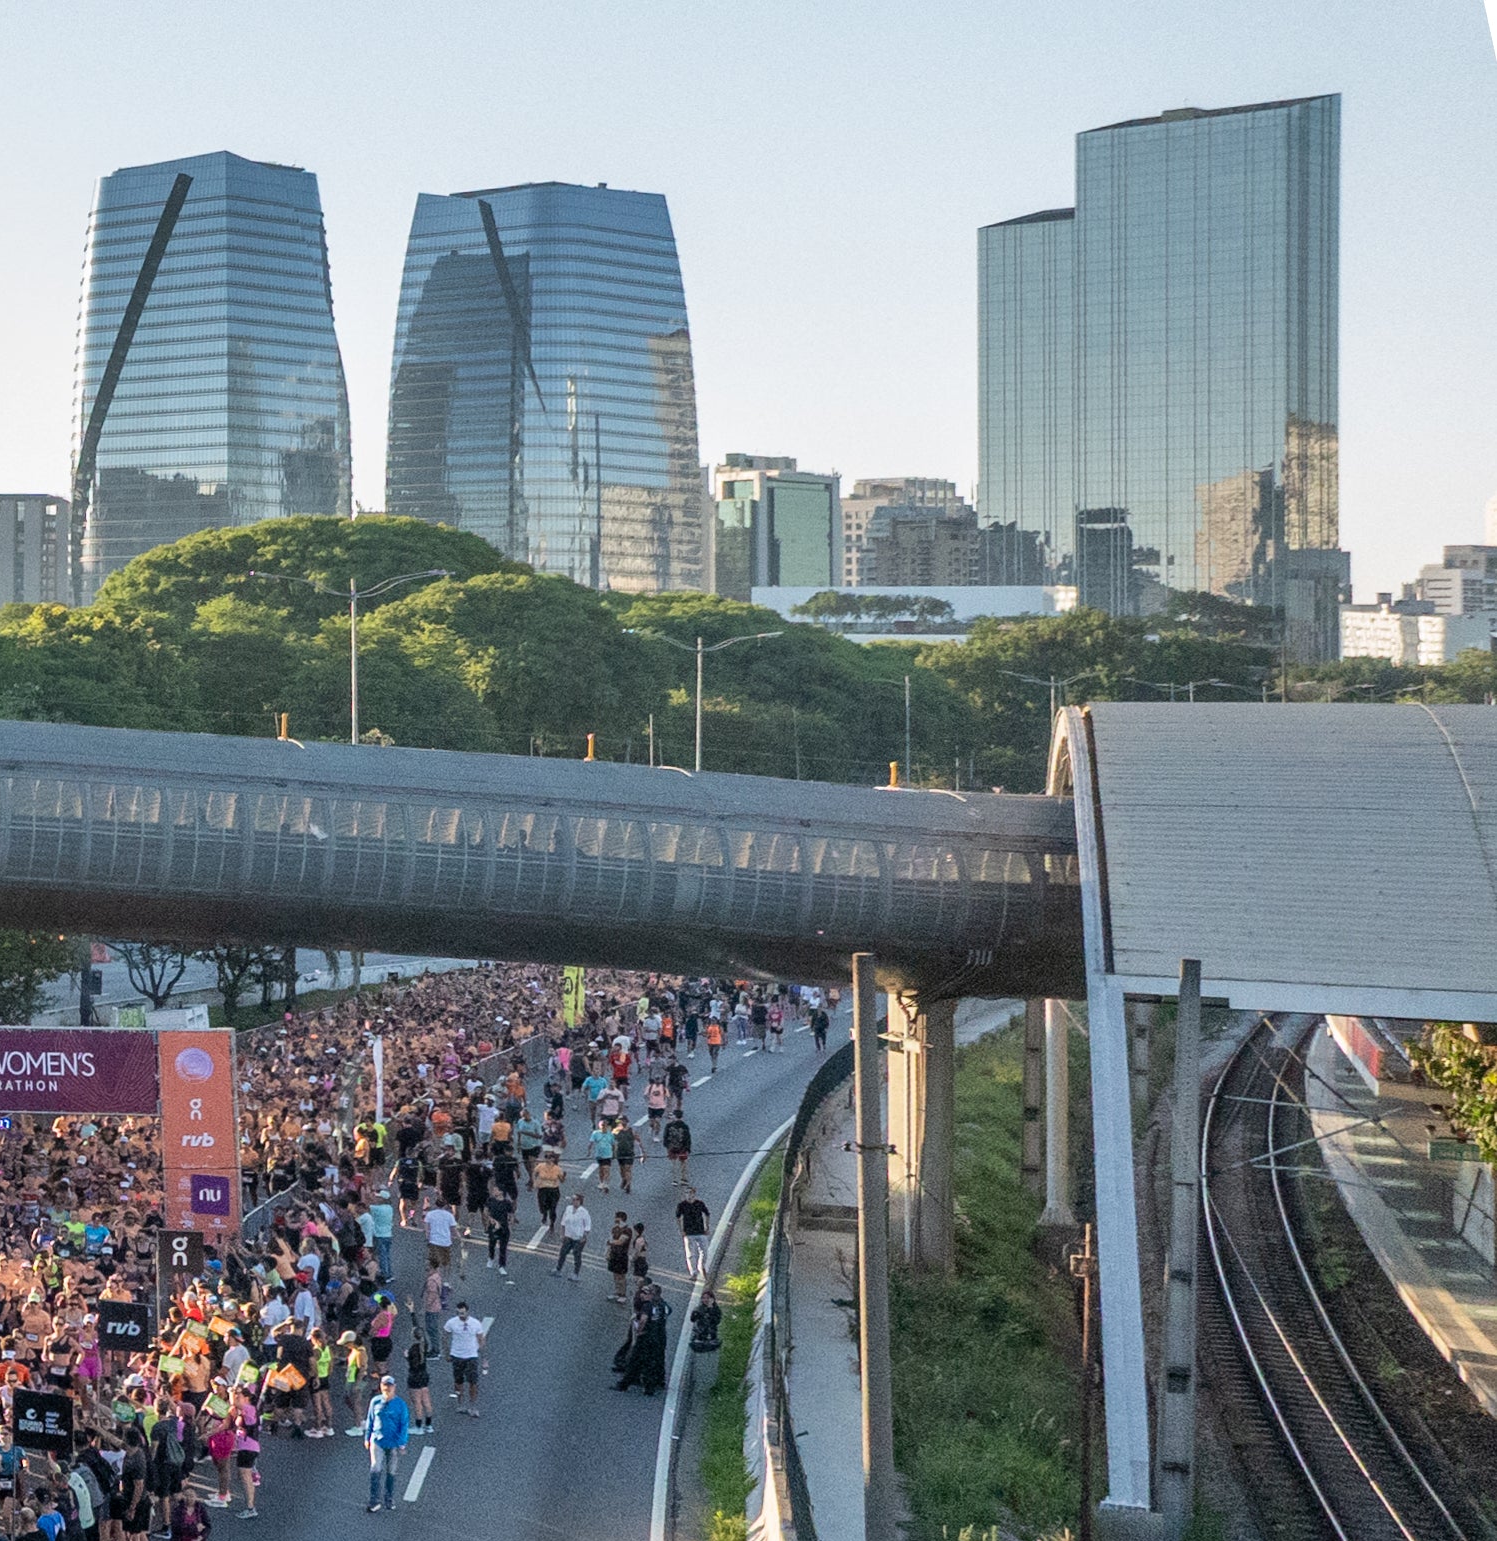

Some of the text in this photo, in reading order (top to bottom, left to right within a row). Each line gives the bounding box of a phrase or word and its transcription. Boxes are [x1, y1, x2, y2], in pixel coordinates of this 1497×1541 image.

[181, 1132, 215, 1147] rvb
[199, 1187, 222, 1202] nu
[107, 1321, 141, 1336] rvb
